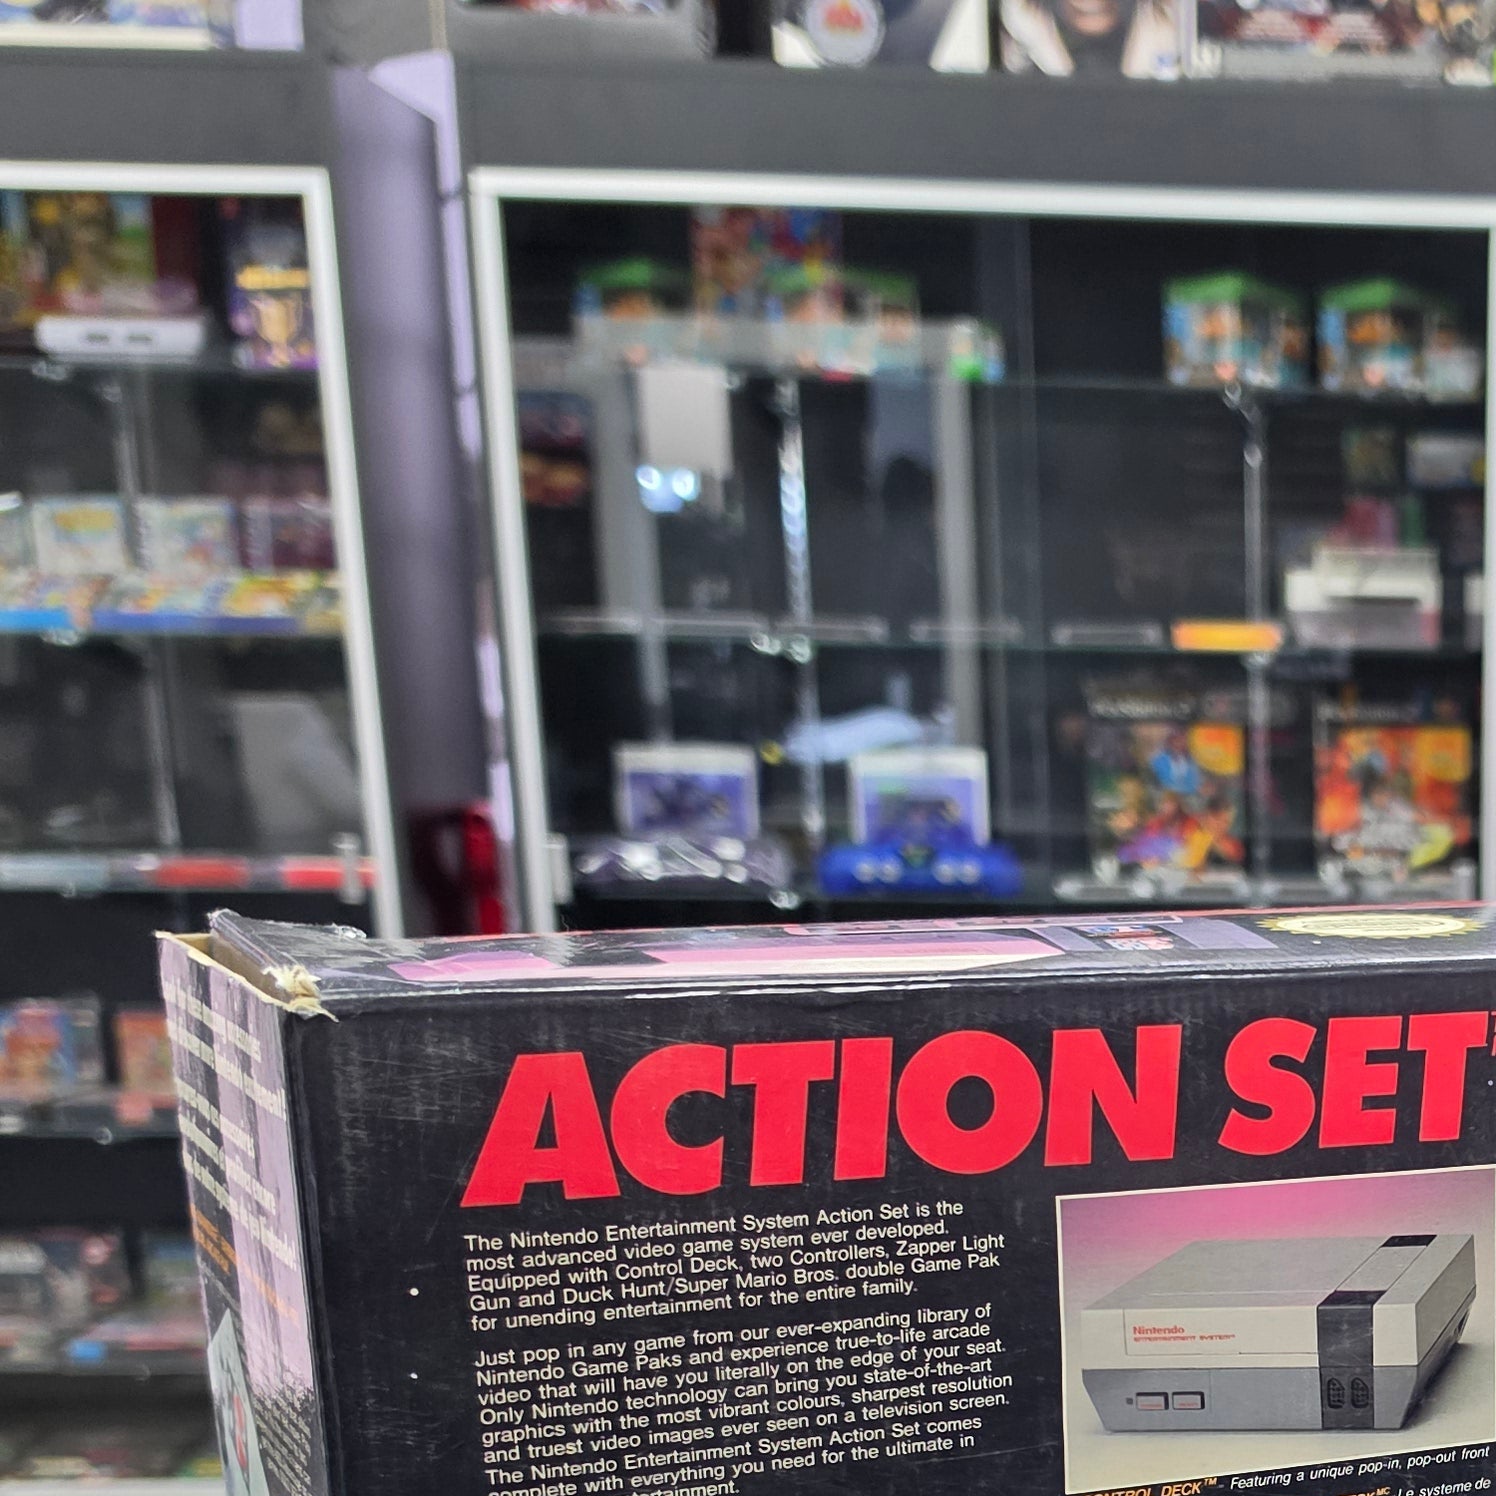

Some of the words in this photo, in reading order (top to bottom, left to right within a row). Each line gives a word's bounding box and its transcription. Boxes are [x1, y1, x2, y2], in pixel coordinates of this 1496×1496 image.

[460, 1024, 1183, 1208] ACTION
[1219, 1009, 1490, 1156] SET
[463, 1234, 503, 1251] The
[510, 1227, 598, 1248] Nintendo
[605, 1216, 736, 1242] Entertainment
[742, 1213, 809, 1233] System
[816, 1207, 873, 1225] Action
[879, 1203, 909, 1220] Set
[915, 1201, 930, 1217] is
[935, 1200, 963, 1216] the
[466, 1253, 514, 1272] most
[521, 1244, 617, 1267] advanced
[623, 1241, 675, 1259] video
[682, 1238, 733, 1259] game
[739, 1233, 804, 1253] system
[810, 1229, 849, 1244] ever
[855, 1218, 949, 1242] developed.
[467, 1269, 560, 1297] Equipped
[567, 1266, 608, 1284] with
[614, 1258, 683, 1280] Control
[690, 1254, 743, 1275] Deck,
[749, 1254, 783, 1269] two
[789, 1244, 889, 1269] Controllers,
[895, 1239, 956, 1260] Zapper
[962, 1233, 1005, 1255] Light
[469, 1294, 510, 1311] Gun
[518, 1288, 555, 1308] and
[562, 1285, 614, 1304] Duck
[620, 1277, 728, 1299] Hunt/Super
[735, 1271, 787, 1289] Mario
[793, 1268, 839, 1284] Bros.
[845, 1260, 905, 1279] double
[910, 1257, 961, 1273] Game
[967, 1251, 1000, 1268] Pak
[1133, 1325, 1185, 1336] Nintendo
[1230, 1472, 1292, 1490] Featuring
[1296, 1471, 1304, 1481] a
[1309, 1465, 1354, 1480] unique
[1357, 1457, 1402, 1476] pop-in,
[1406, 1450, 1456, 1470] pop-out
[1461, 1445, 1490, 1460] front
[1474, 1476, 1491, 1490] de
